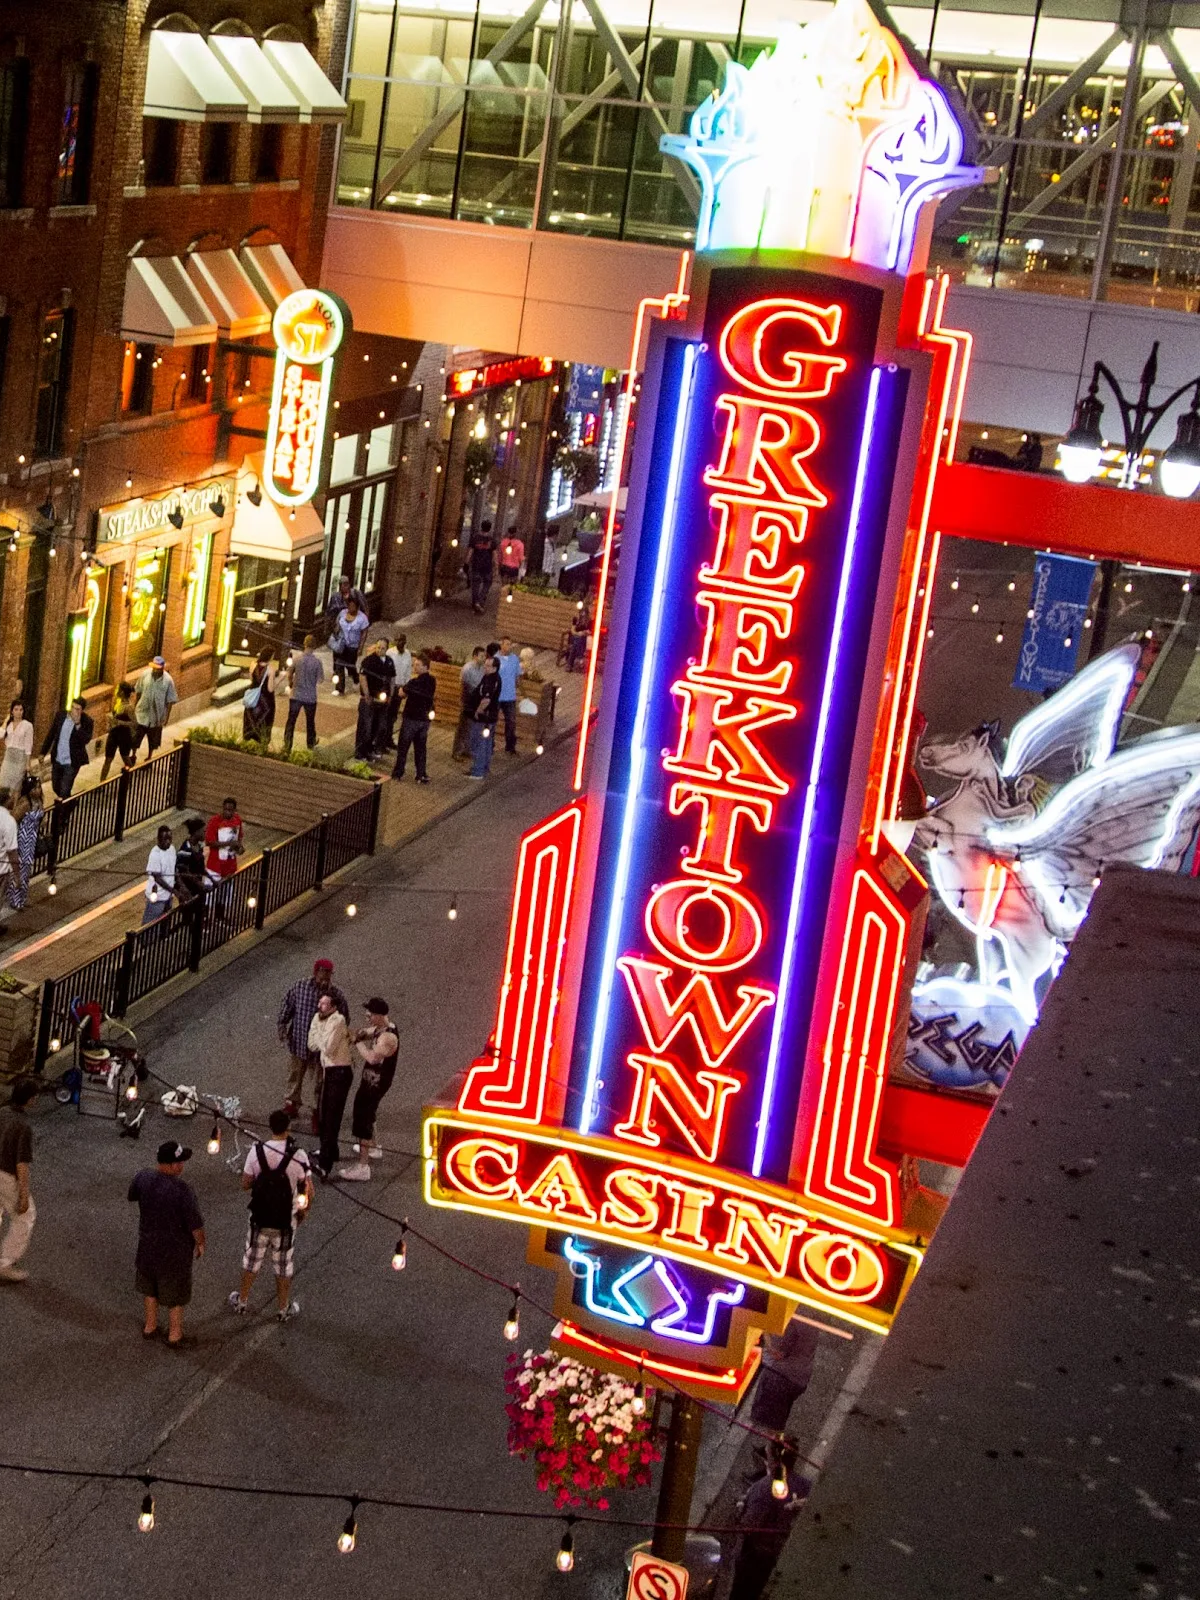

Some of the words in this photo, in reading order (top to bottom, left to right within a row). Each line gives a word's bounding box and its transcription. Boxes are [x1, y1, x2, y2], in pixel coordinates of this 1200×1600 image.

[273, 364, 303, 478] STEAK
[291, 379, 321, 492] HOUSE
[615, 297, 847, 1163] GREEKTOWN
[445, 1137, 885, 1303] CASINO
